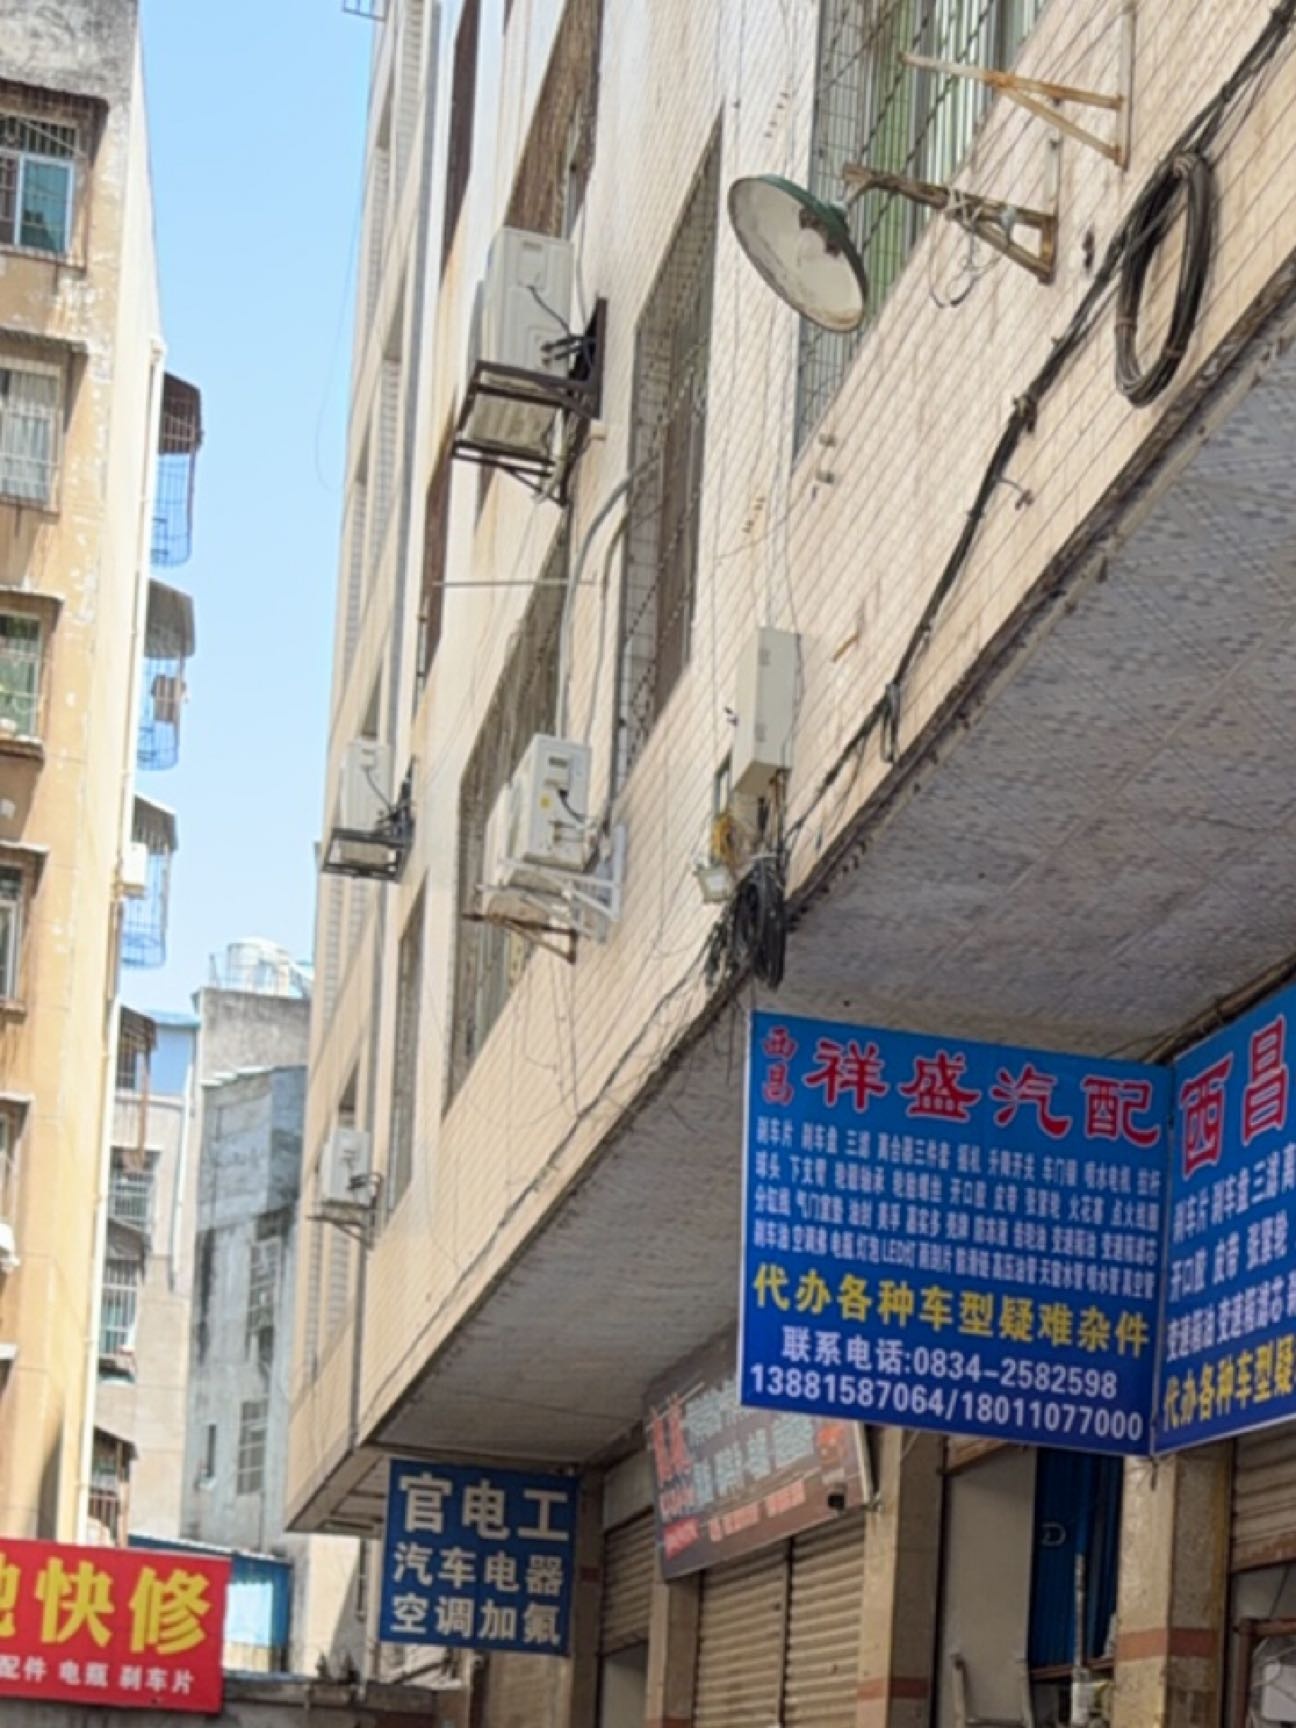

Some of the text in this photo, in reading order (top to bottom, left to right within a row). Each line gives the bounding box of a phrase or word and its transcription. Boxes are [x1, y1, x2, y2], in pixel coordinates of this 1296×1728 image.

[800, 1036, 1161, 1148] 祥盛汽配
[752, 1262, 1148, 1357] 代办各种车型疑难杂件
[781, 1324, 1117, 1400] 联系电话:0834-2582598
[749, 1362, 1143, 1441] 13881587064/18011077000
[399, 1472, 569, 1541] 官电工
[394, 1541, 562, 1596] 汽车电器
[119, 1664, 194, 1695] 刹车片
